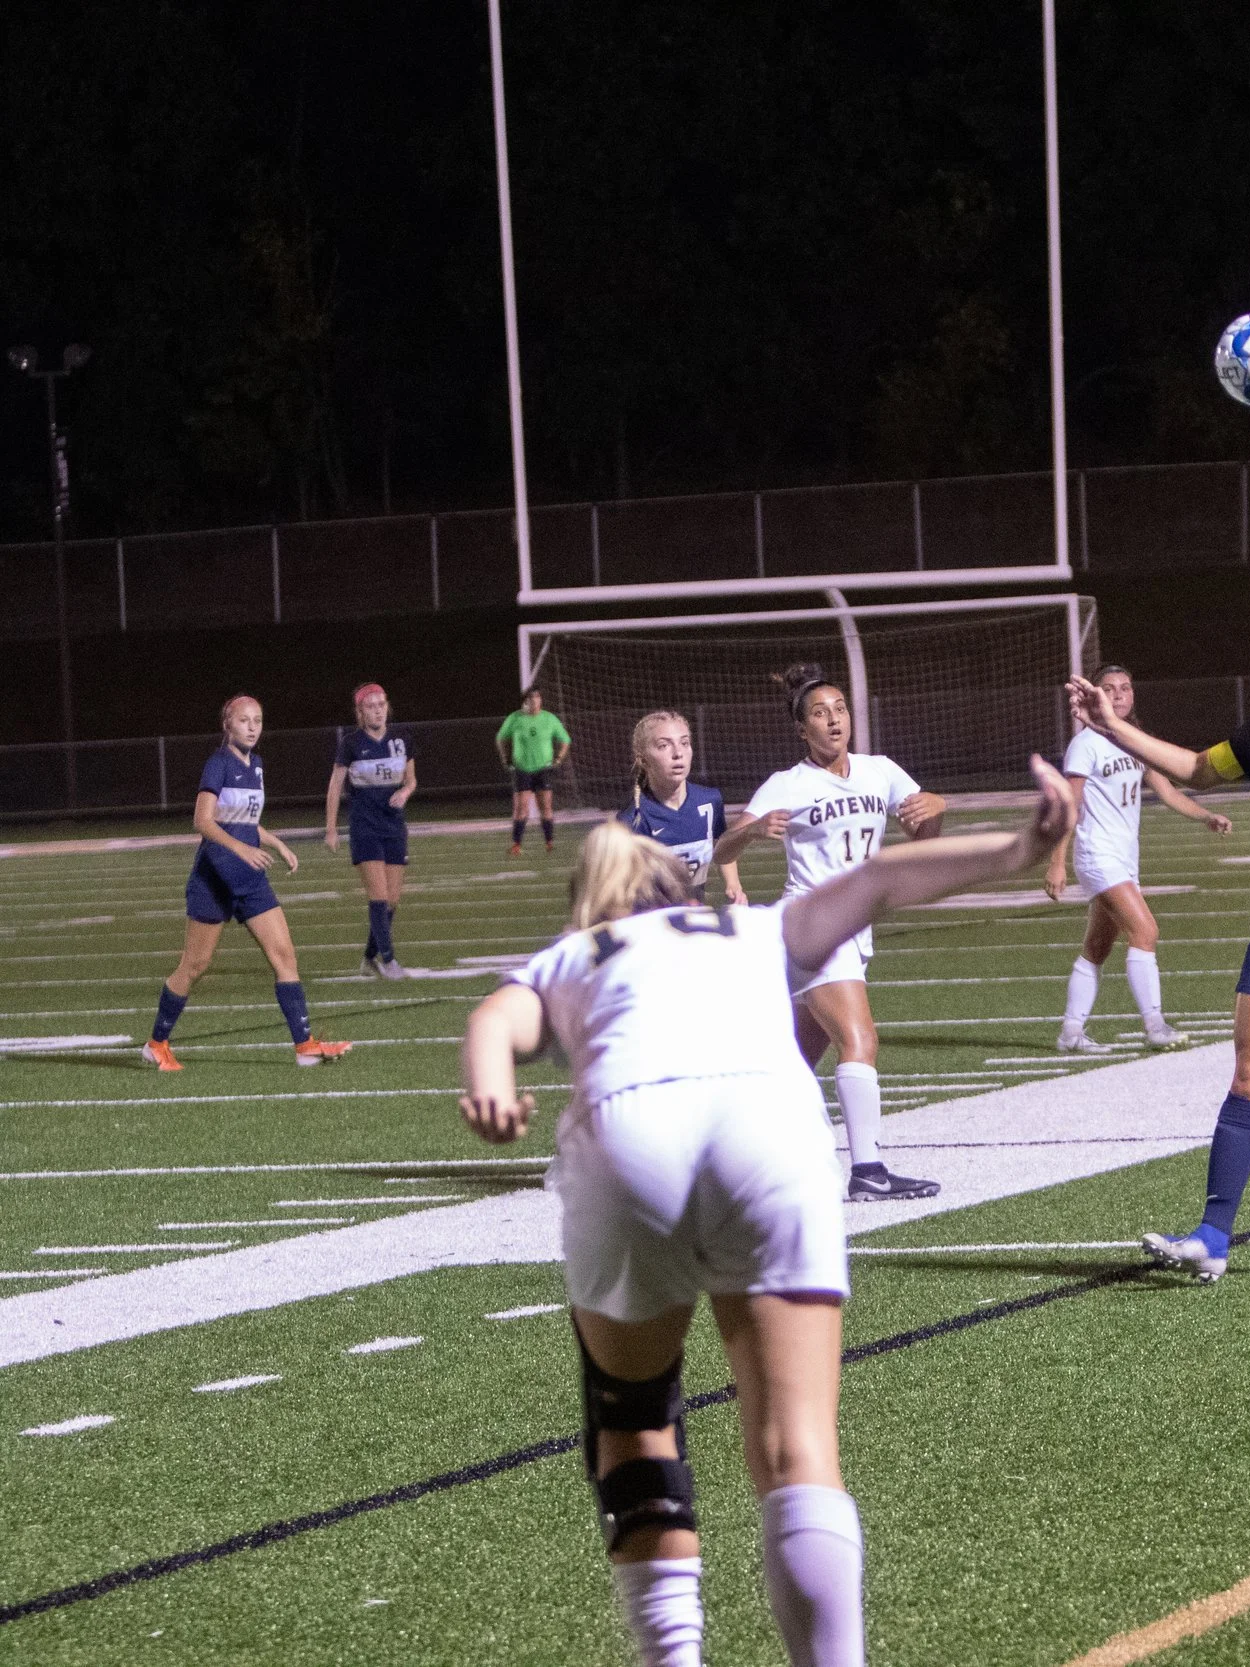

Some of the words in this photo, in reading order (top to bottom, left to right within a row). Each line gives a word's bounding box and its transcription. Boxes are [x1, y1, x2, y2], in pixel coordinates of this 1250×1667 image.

[1121, 781, 1138, 807] 14
[809, 795, 886, 826] GATEWA
[843, 827, 875, 862] 17
